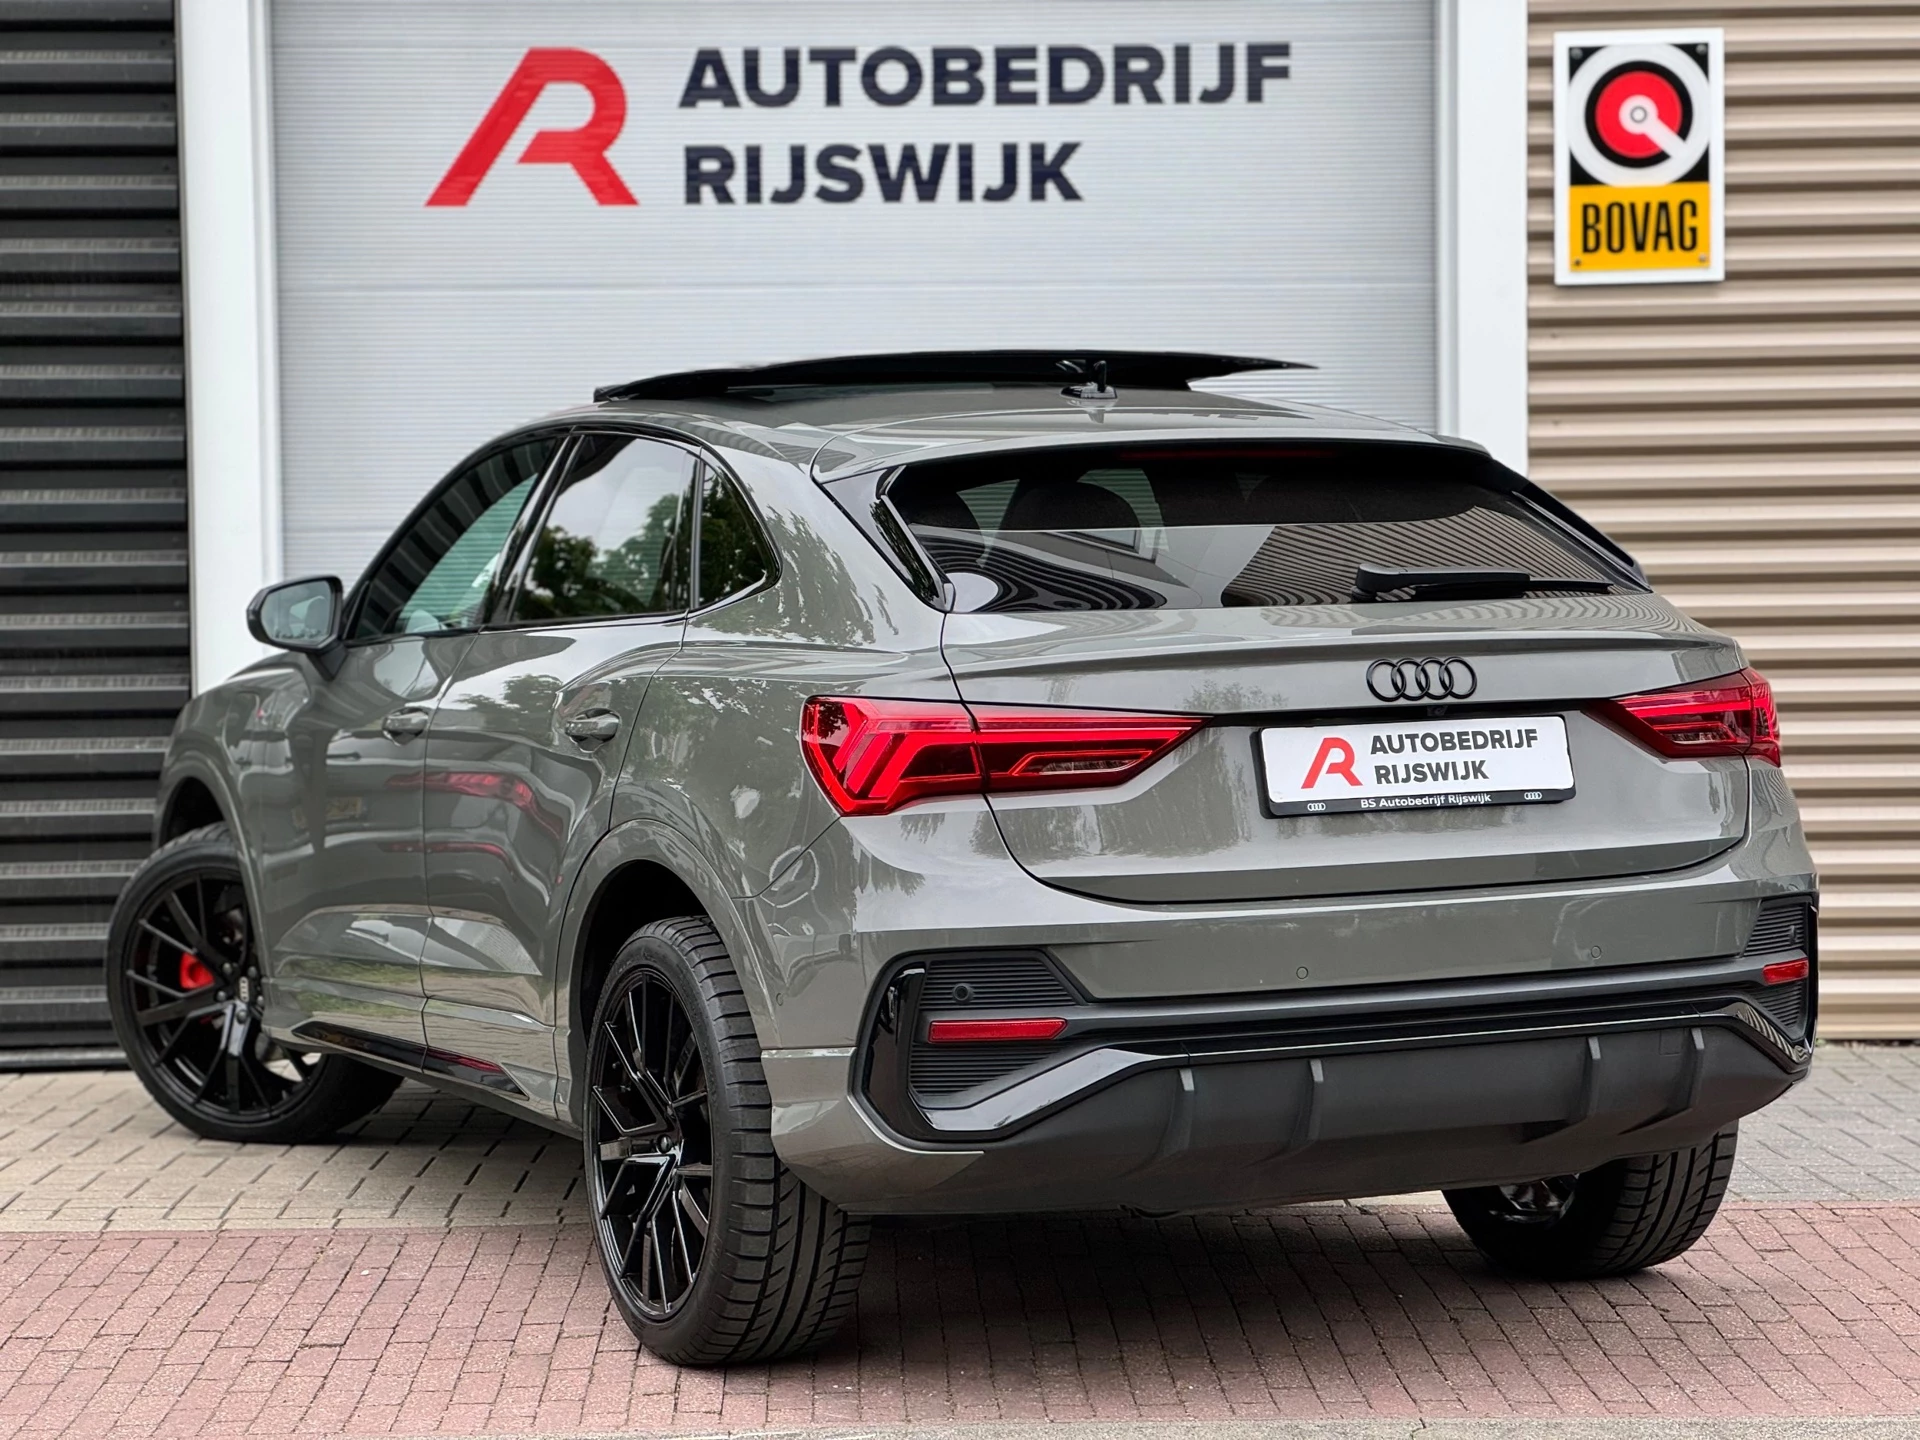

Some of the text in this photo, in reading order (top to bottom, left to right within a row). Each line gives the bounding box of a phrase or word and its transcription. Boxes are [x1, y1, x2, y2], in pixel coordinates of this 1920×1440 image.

[679, 43, 1292, 108] AUTOBEDRIJF
[683, 141, 1085, 205] RIJSWIJK
[1582, 200, 1697, 253] BOVAG
[1371, 729, 1538, 754] AUTOBEDRIJF
[1375, 760, 1489, 784] RIJSWIJK
[1360, 794, 1491, 809] BS Autobedrijf Rijswijk
